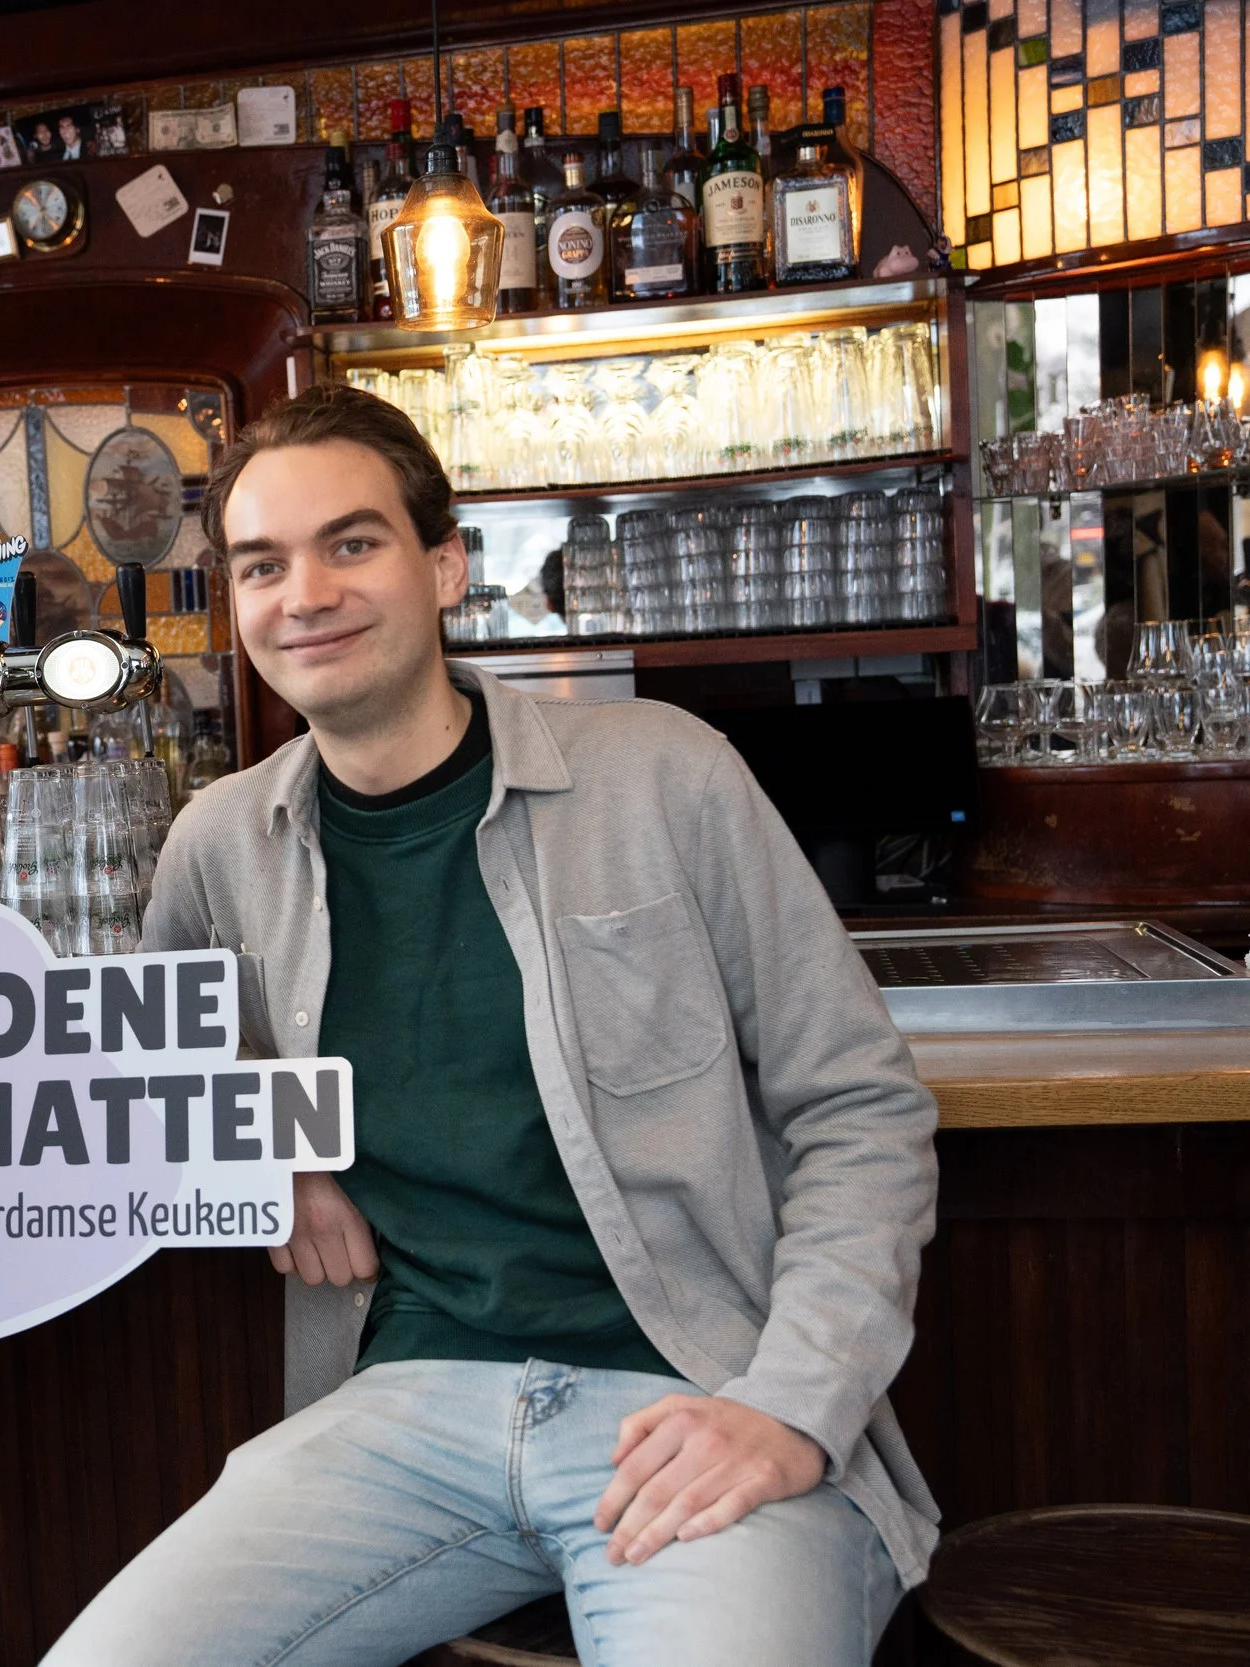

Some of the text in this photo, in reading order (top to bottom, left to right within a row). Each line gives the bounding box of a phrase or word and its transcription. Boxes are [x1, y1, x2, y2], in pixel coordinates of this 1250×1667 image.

[708, 176, 760, 197] JAMESON
[790, 212, 836, 227] DISARONNO
[559, 238, 593, 251] NONINO
[128, 1188, 280, 1237] Keukens
